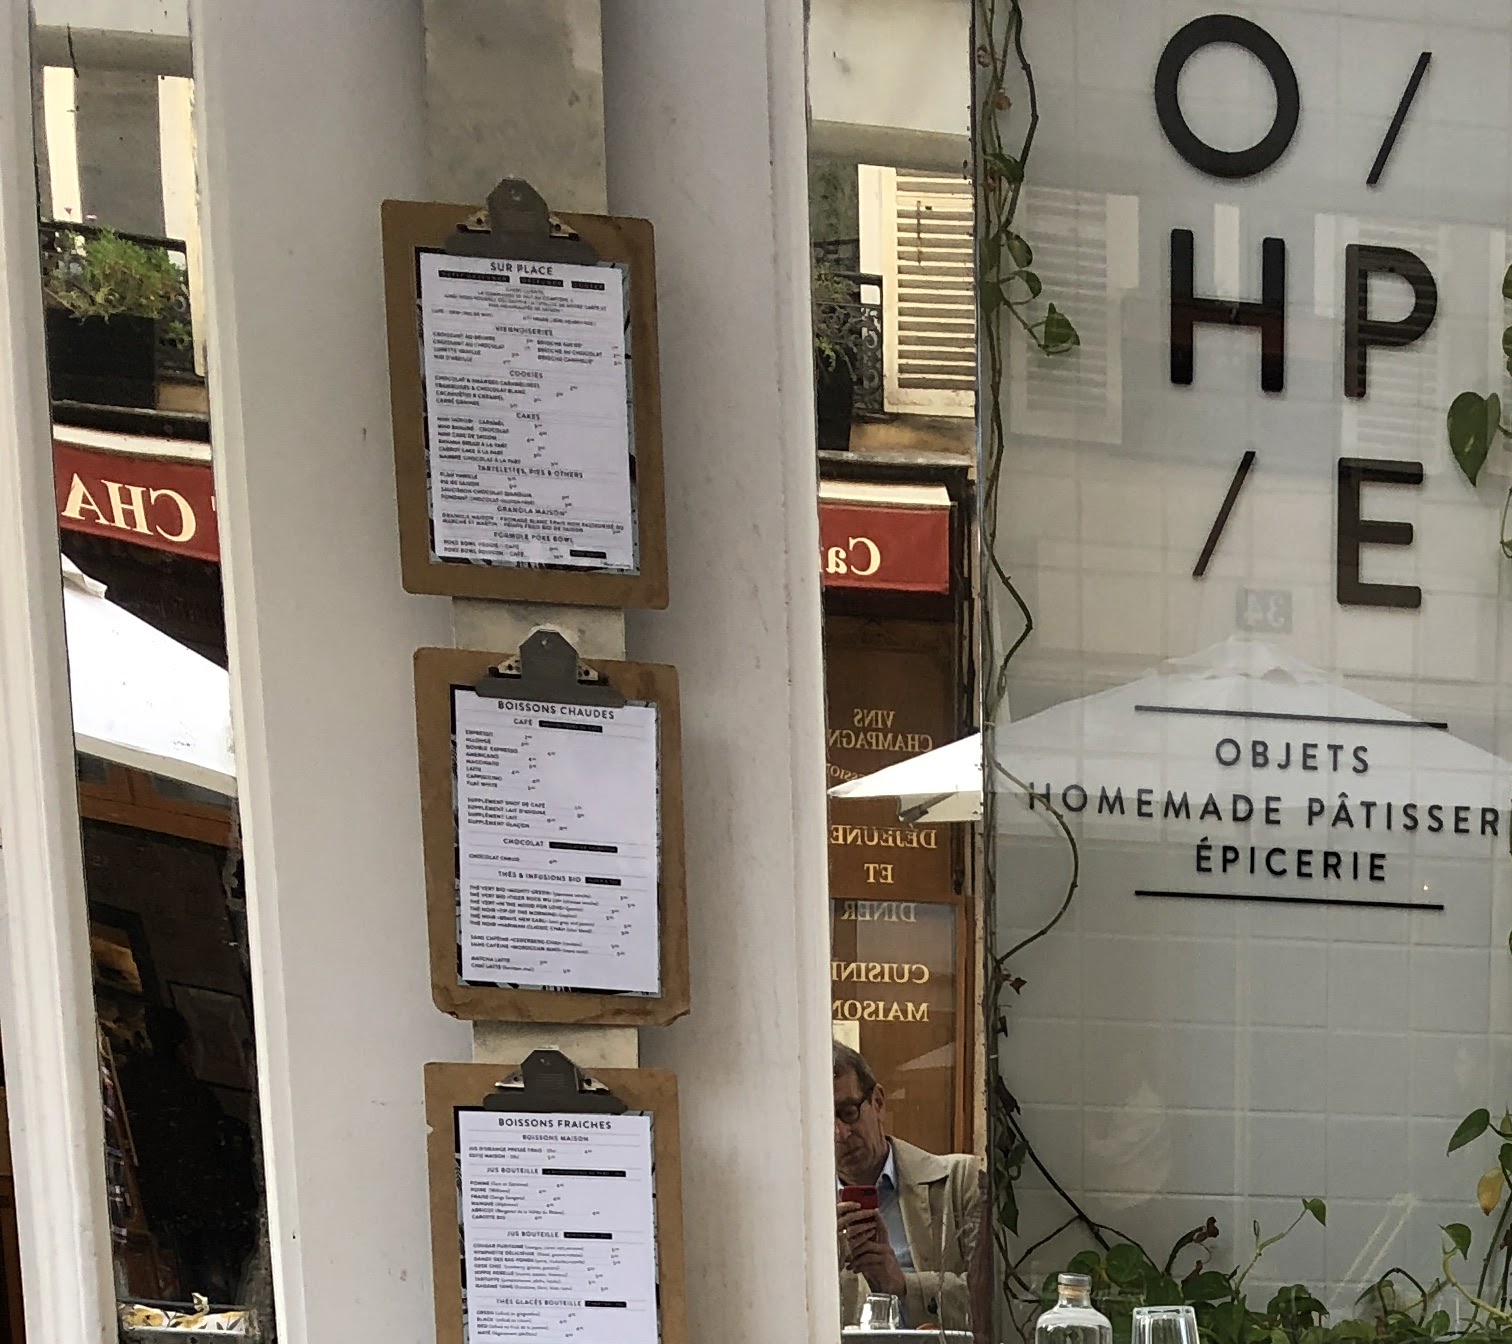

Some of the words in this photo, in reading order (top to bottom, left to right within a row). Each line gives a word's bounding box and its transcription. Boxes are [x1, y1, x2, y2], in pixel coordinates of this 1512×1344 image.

[490, 262, 513, 273] SUR
[517, 263, 553, 276] PLACE
[509, 370, 544, 379] COOKIES
[516, 412, 540, 421] CAKES
[554, 470, 583, 478] OTHERS
[497, 506, 533, 514] GRANOLA
[494, 532, 529, 540] FORMULE
[553, 535, 573, 544] BOWL
[498, 701, 556, 714] BOISSONS
[560, 706, 615, 720] CHAUDES
[514, 718, 533, 726] CAFÉ
[1216, 738, 1370, 774] OBJETS
[1028, 781, 1283, 825] HOMEMADE
[503, 838, 544, 847] CHOCOLAT
[1196, 837, 1387, 882] ÉPICERIE
[498, 870, 516, 879] THÉS
[526, 874, 565, 882] INFUSIONS
[499, 1118, 554, 1128] BOISSONS
[558, 1120, 612, 1130] FRAICHES
